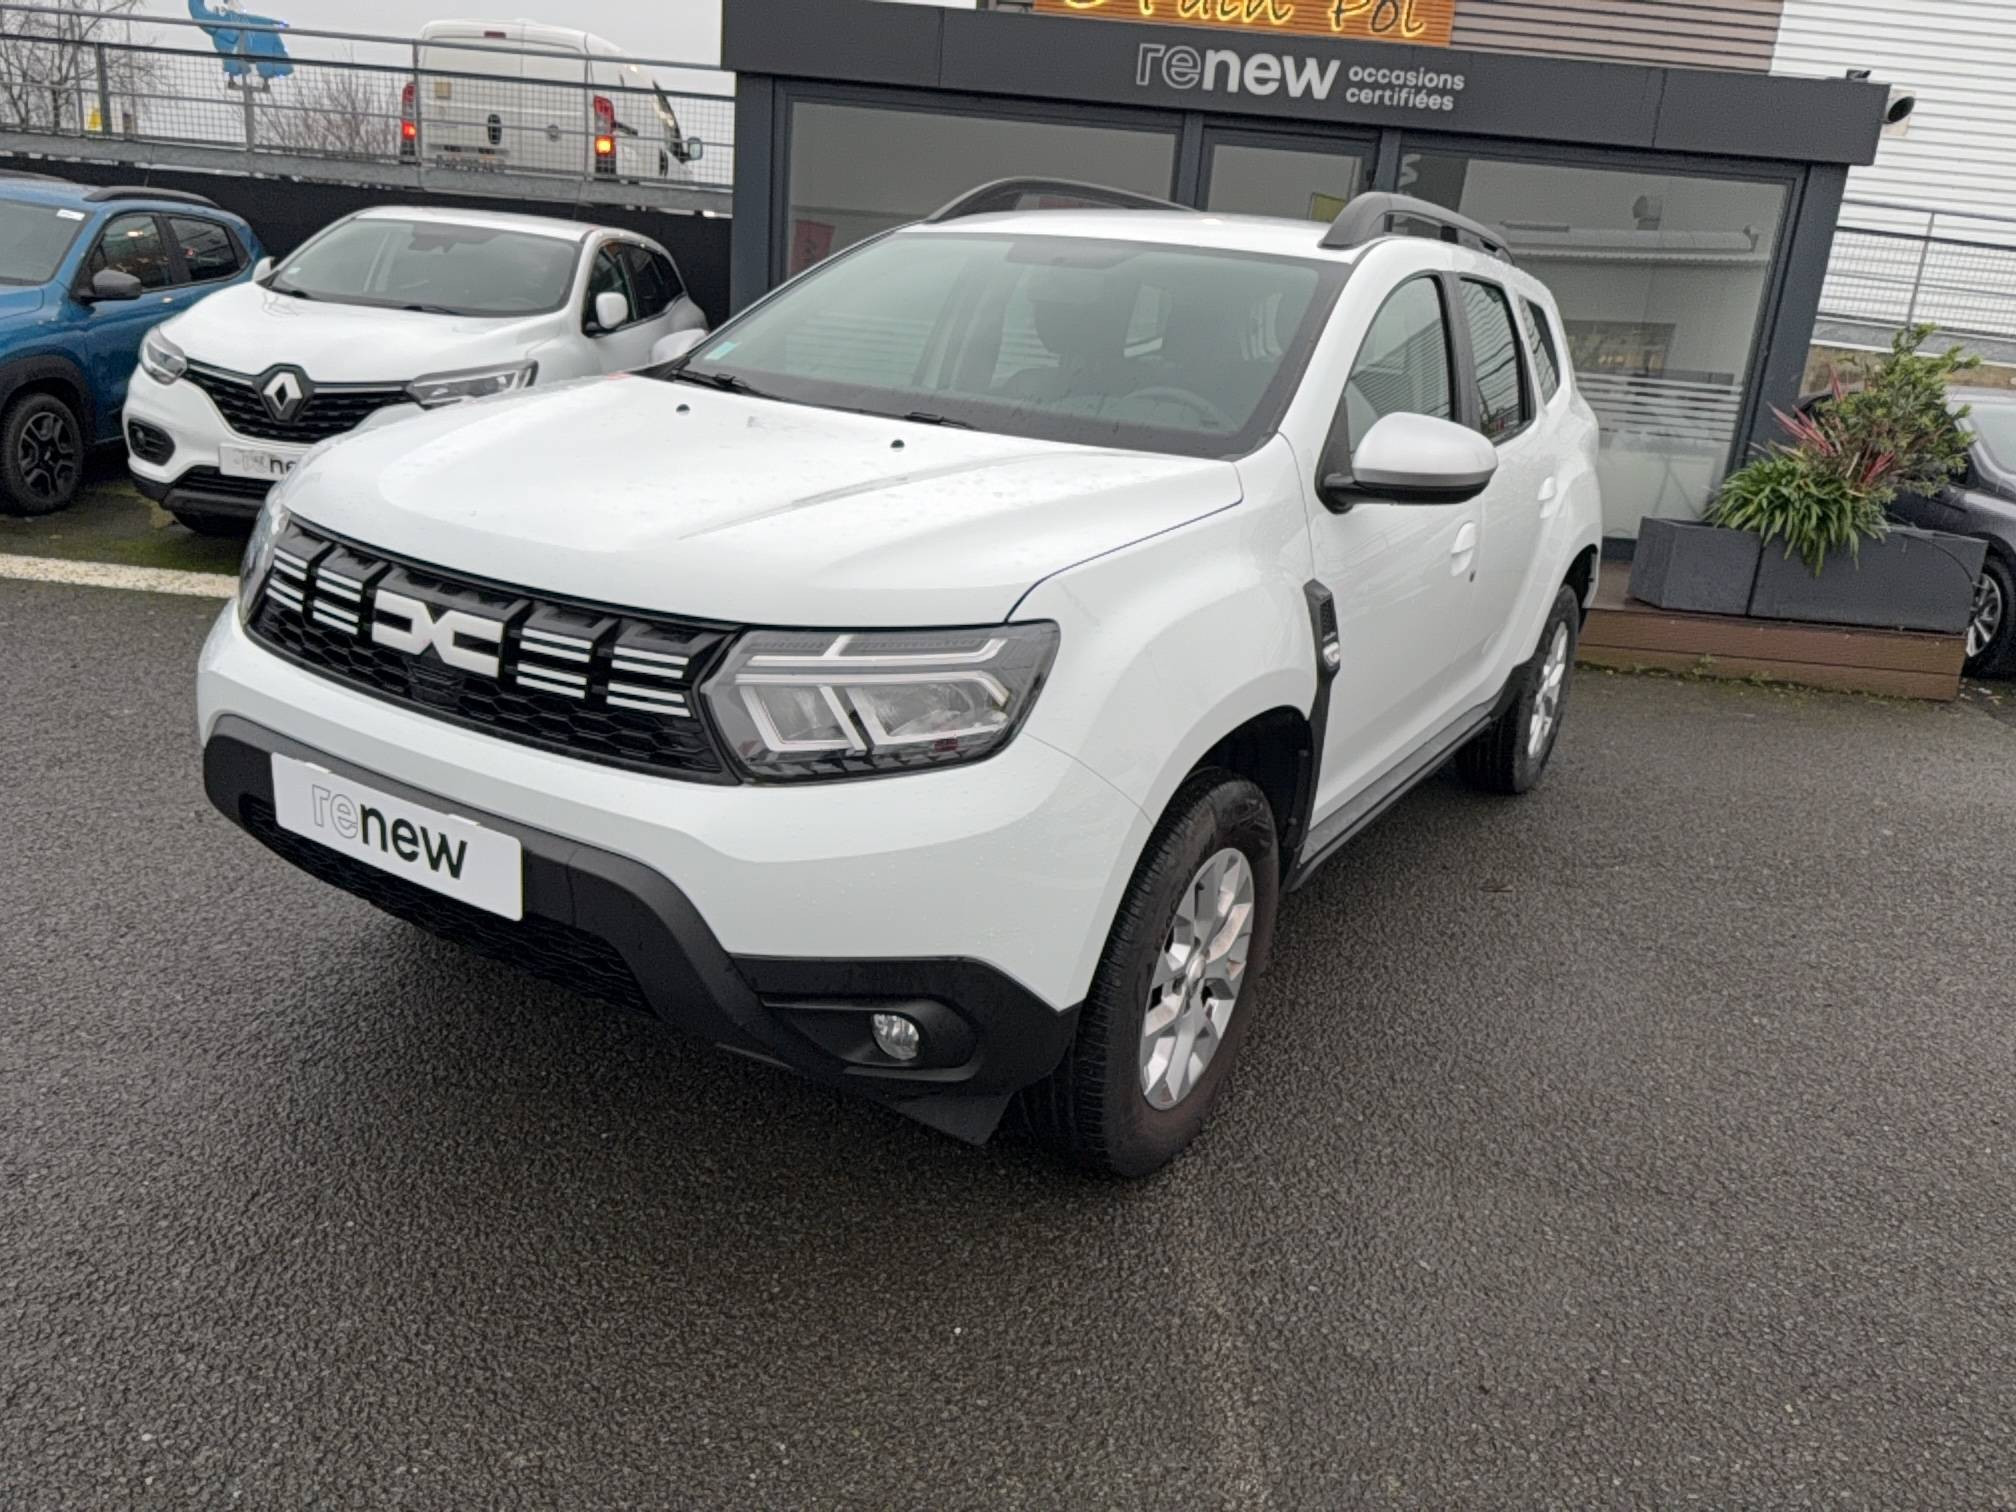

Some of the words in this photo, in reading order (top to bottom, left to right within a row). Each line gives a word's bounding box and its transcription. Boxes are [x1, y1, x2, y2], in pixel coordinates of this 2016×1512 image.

[1136, 43, 1341, 100] renew
[1348, 65, 1465, 91] occasions
[1345, 86, 1455, 111] certifiées
[312, 784, 468, 880] renew
